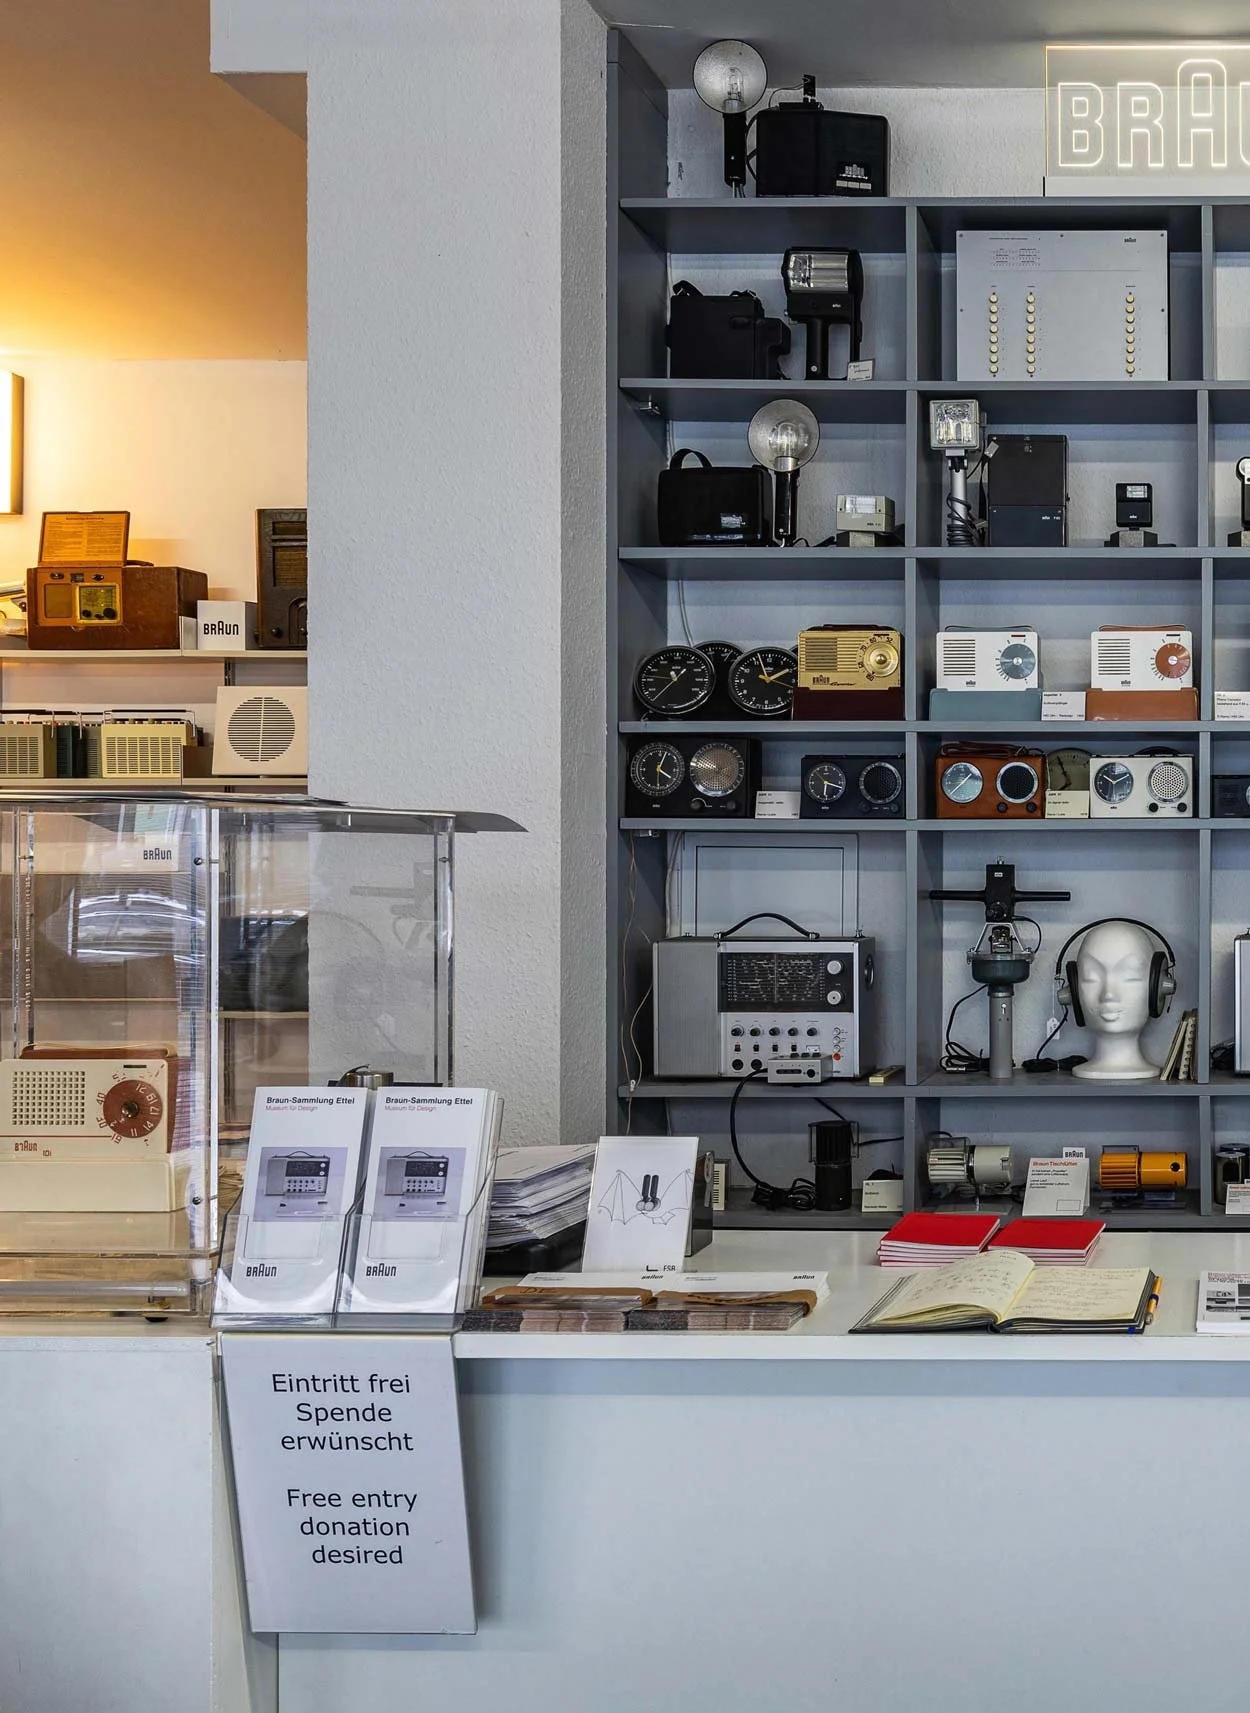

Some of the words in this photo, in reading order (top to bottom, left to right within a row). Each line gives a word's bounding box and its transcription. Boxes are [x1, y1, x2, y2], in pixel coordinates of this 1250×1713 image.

[203, 619, 240, 636] BRAUN
[143, 846, 172, 860] BRAUN
[266, 1096, 333, 1105] Braun-Sammlung
[386, 1096, 452, 1105] Braun-Sammlung
[246, 1264, 277, 1277] BRAUN
[366, 1263, 396, 1277] BRAUN
[272, 1374, 360, 1393] Eintritt
[368, 1374, 410, 1393] frei
[296, 1402, 392, 1426] Spende
[281, 1431, 414, 1452] erwünscht
[287, 1488, 341, 1508] Free
[352, 1490, 418, 1512] entry
[300, 1516, 410, 1536] donation
[312, 1545, 403, 1564] desired
